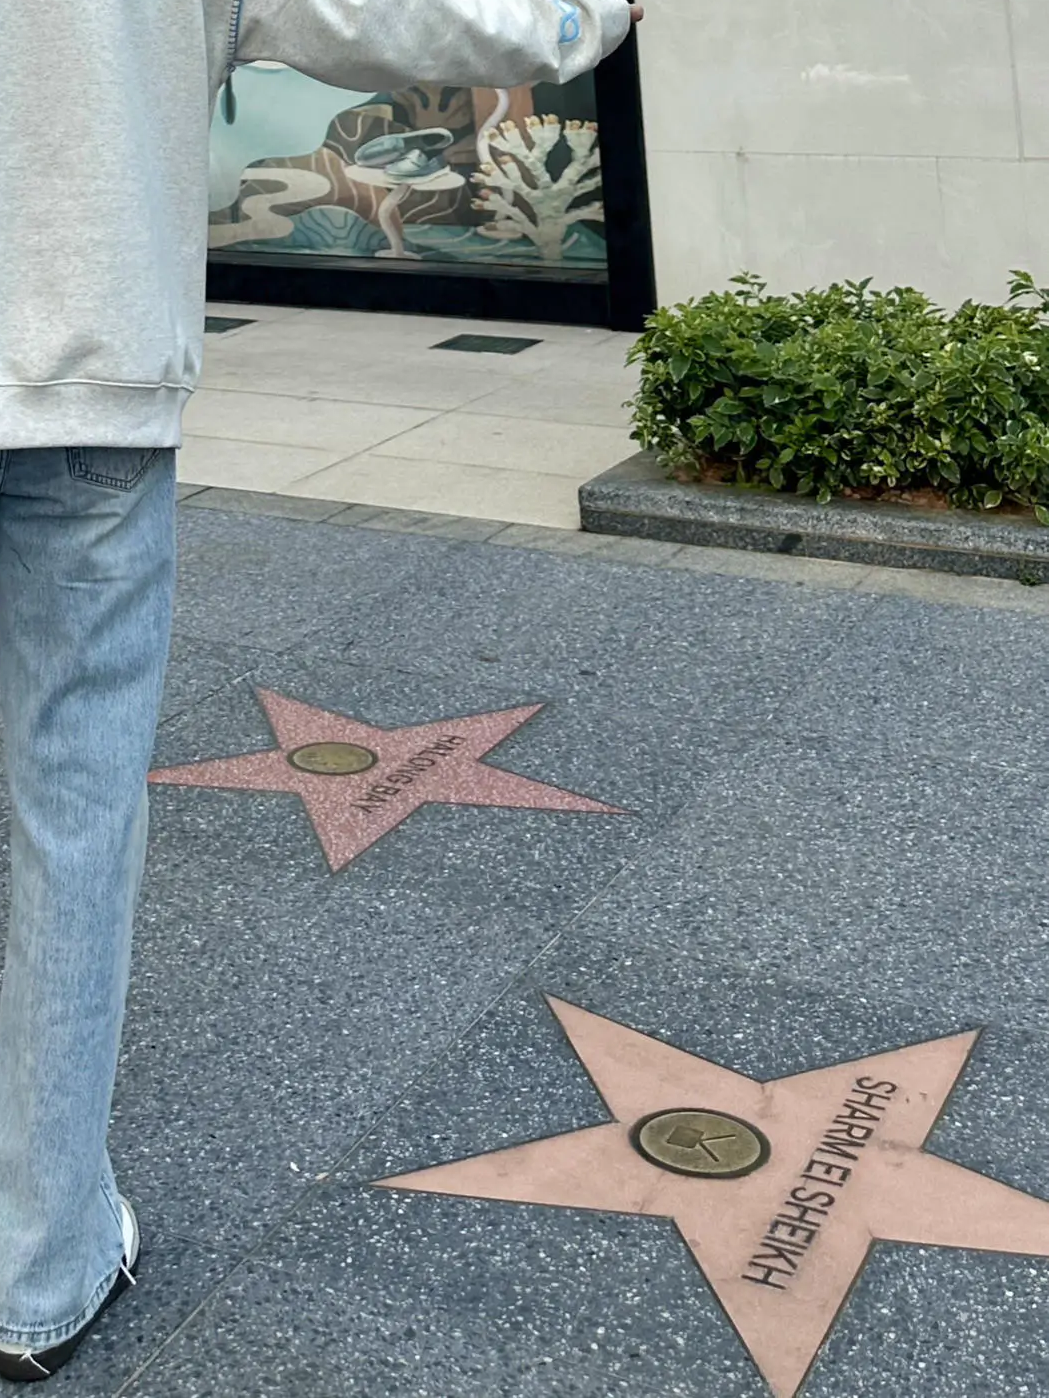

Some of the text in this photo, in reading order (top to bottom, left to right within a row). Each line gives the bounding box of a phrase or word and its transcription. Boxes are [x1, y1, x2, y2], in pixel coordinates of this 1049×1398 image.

[349, 734, 467, 814] HALONG BAY
[814, 1075, 898, 1162] SHARM
[740, 1185, 836, 1291] SHEIKH
